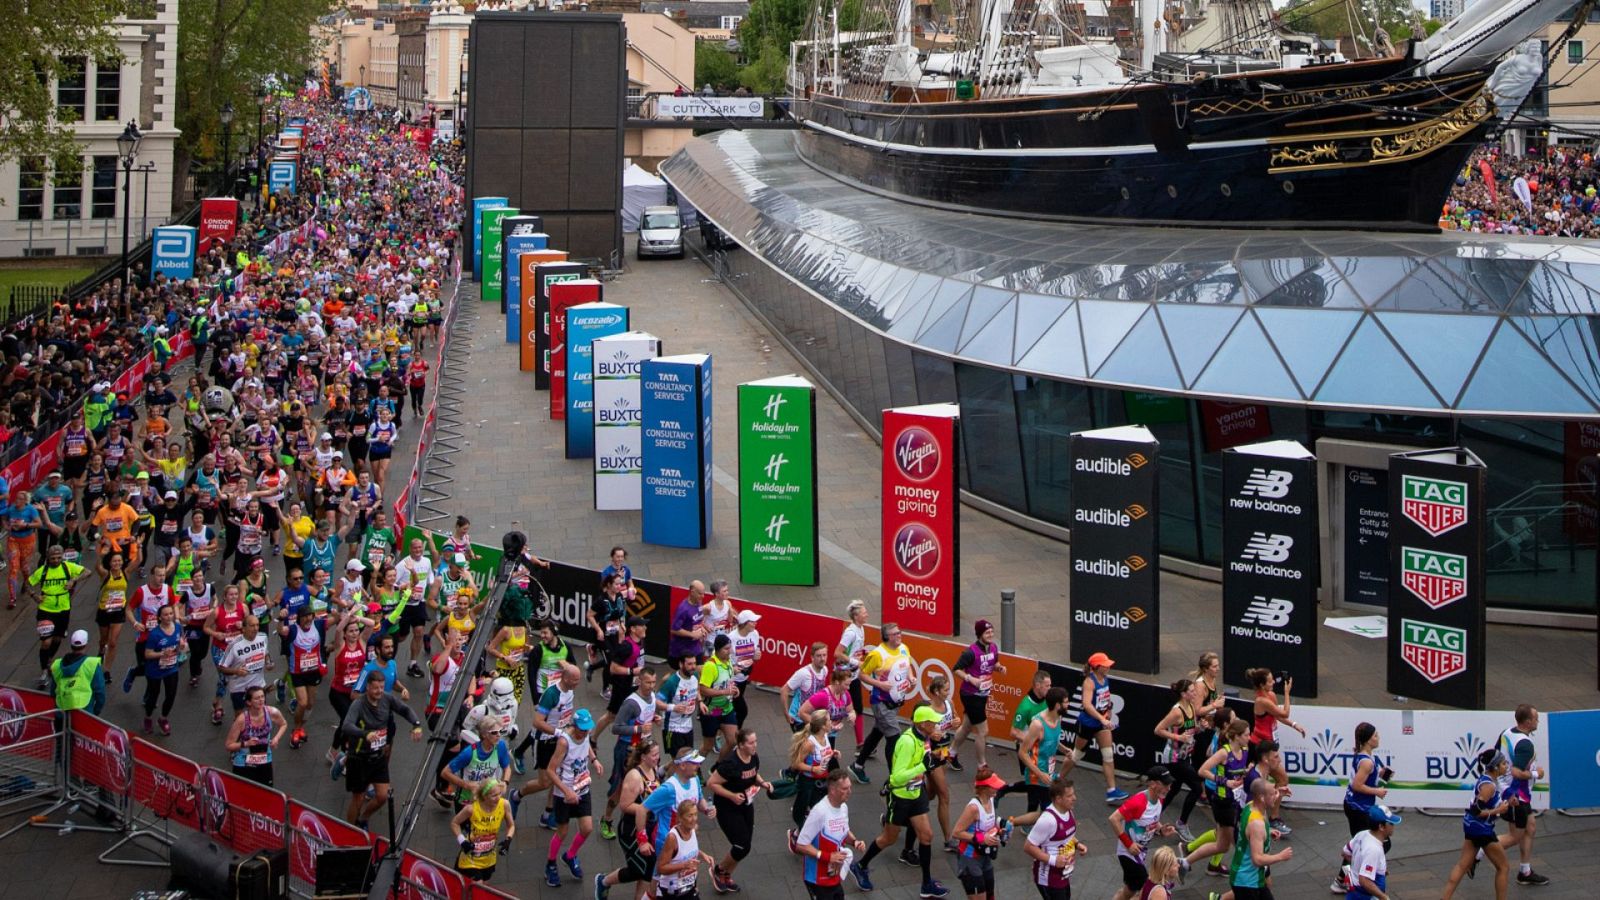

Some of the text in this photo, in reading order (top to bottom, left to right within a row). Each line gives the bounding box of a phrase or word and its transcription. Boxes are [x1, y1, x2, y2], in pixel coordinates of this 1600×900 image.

[1283, 87, 1369, 105] CUTTY SARK
[673, 105, 736, 113] CUTTY SARK
[156, 260, 189, 268] Abbott
[573, 315, 614, 325] Lucozade
[658, 373, 679, 381] TATA
[645, 381, 692, 392] CONSULTANCY
[654, 391, 684, 401] SERVICES
[660, 420, 680, 429] TATA
[752, 422, 799, 433] Holiday Inn
[646, 429, 694, 440] CONSULTANCY
[655, 439, 686, 449] SERVICES
[899, 433, 936, 473] Virgin
[660, 468, 681, 477] TATA
[1075, 457, 1131, 476] audible
[646, 476, 695, 488] CONSULTANCY
[752, 482, 800, 494] Holiday Inn
[655, 487, 686, 497] SERVICES
[895, 484, 940, 503] money
[1408, 480, 1461, 503] TAG
[897, 499, 937, 517] giving
[1230, 498, 1301, 515] new balance
[1075, 508, 1130, 527] audible
[1360, 518, 1379, 528] Cutty
[1406, 501, 1463, 532] HEUER
[1360, 528, 1388, 538] this way
[753, 543, 800, 555] Holiday Inn
[899, 529, 936, 569] Virgin
[1075, 559, 1130, 578] audible
[1230, 562, 1301, 579] new balance
[1407, 552, 1460, 576] TAG
[894, 581, 939, 600] money
[1406, 574, 1462, 605] HEUER
[536, 591, 592, 628] audi
[897, 595, 937, 615] giving
[1075, 609, 1130, 630] audible
[737, 638, 753, 646] GILL
[1231, 625, 1301, 645] new balance
[1407, 624, 1460, 650] TAG
[237, 642, 265, 656] ROBIN
[1405, 646, 1461, 678] HEUER
[1060, 729, 1076, 743] ew
[1284, 751, 1391, 776] BUXTN
[1425, 756, 1479, 779] BUX
